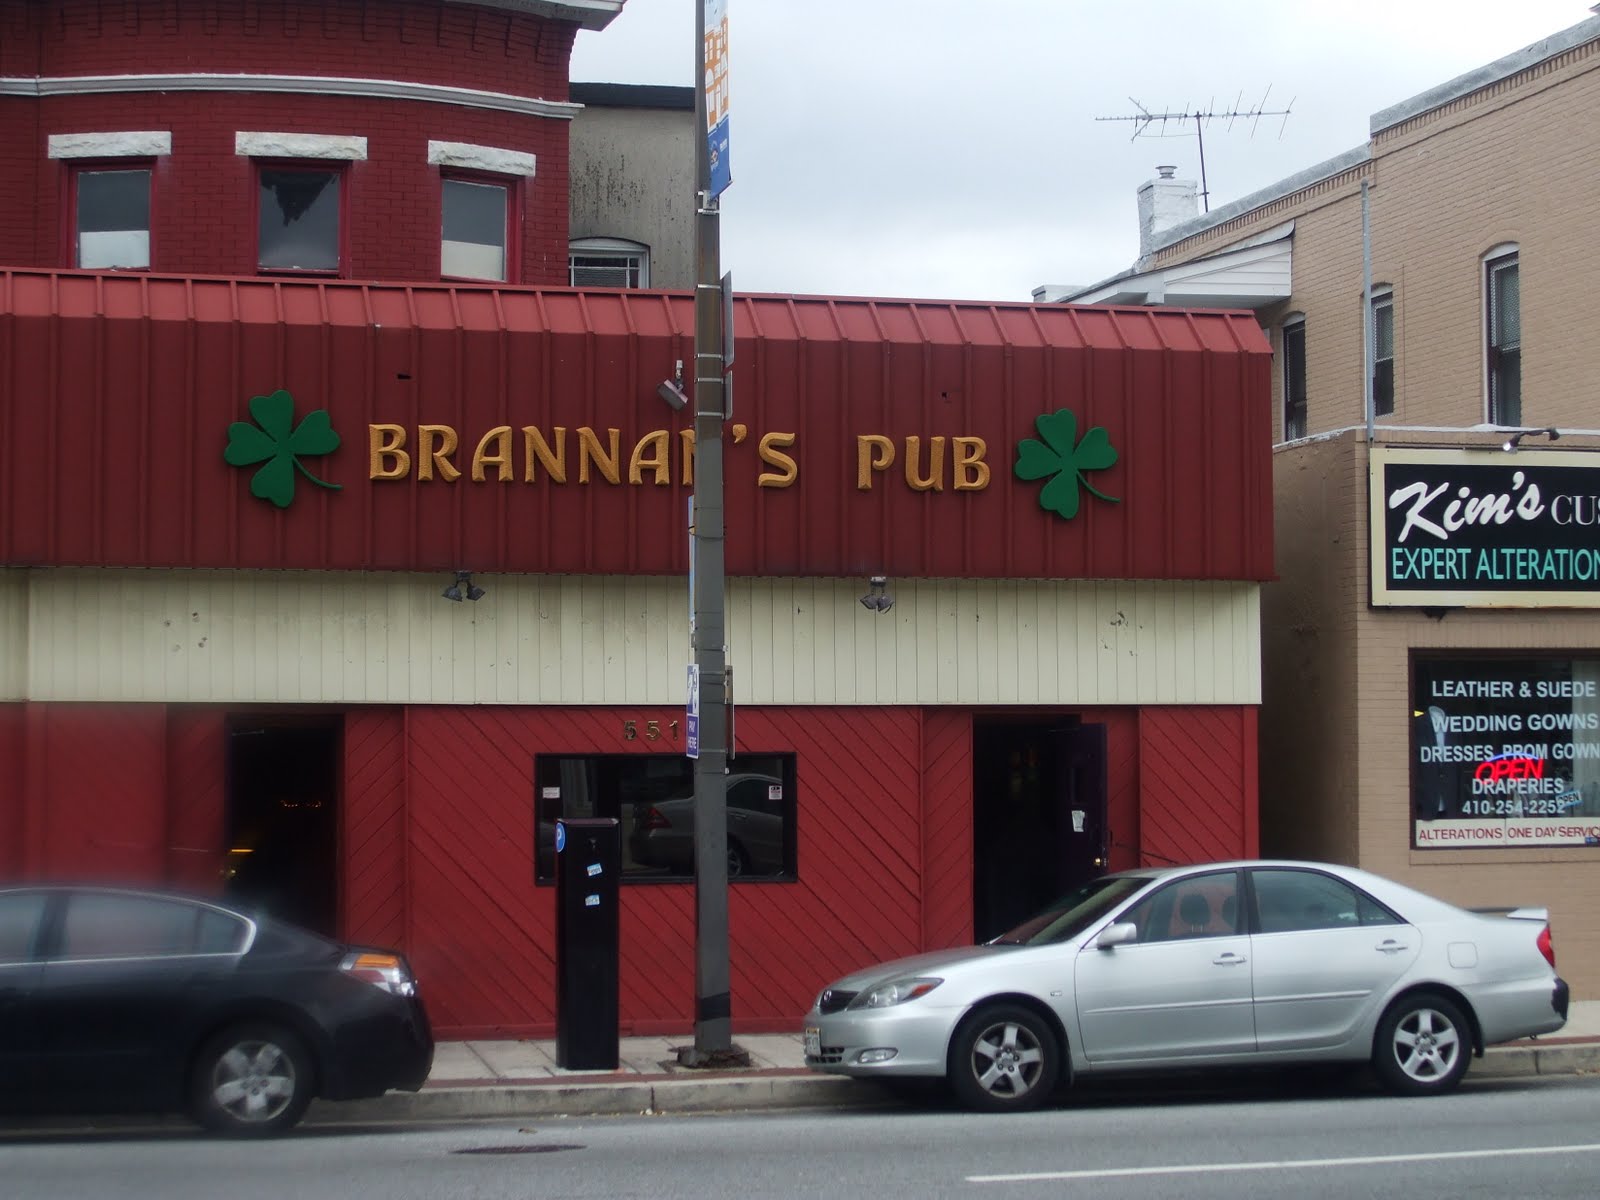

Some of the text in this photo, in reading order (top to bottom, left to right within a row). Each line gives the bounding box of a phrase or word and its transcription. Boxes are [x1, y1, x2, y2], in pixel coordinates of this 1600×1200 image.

[857, 434, 990, 491] PUB
[1389, 471, 1600, 543] Kim's CU
[1392, 548, 1471, 580] EXPERT
[1432, 681, 1596, 698] LEATHER & SUEDE
[624, 720, 678, 740] 551
[1432, 713, 1598, 733] WEDDING GOWNS
[1503, 743, 1548, 760] PROM
[1474, 757, 1544, 784] OPEN
[1472, 778, 1564, 794] DRAPERIES
[1462, 800, 1565, 815] 410-254-2252
[1419, 827, 1503, 841] ALTERATIONS
[1507, 827, 1532, 839] ONE
[1535, 826, 1557, 838] DAY
